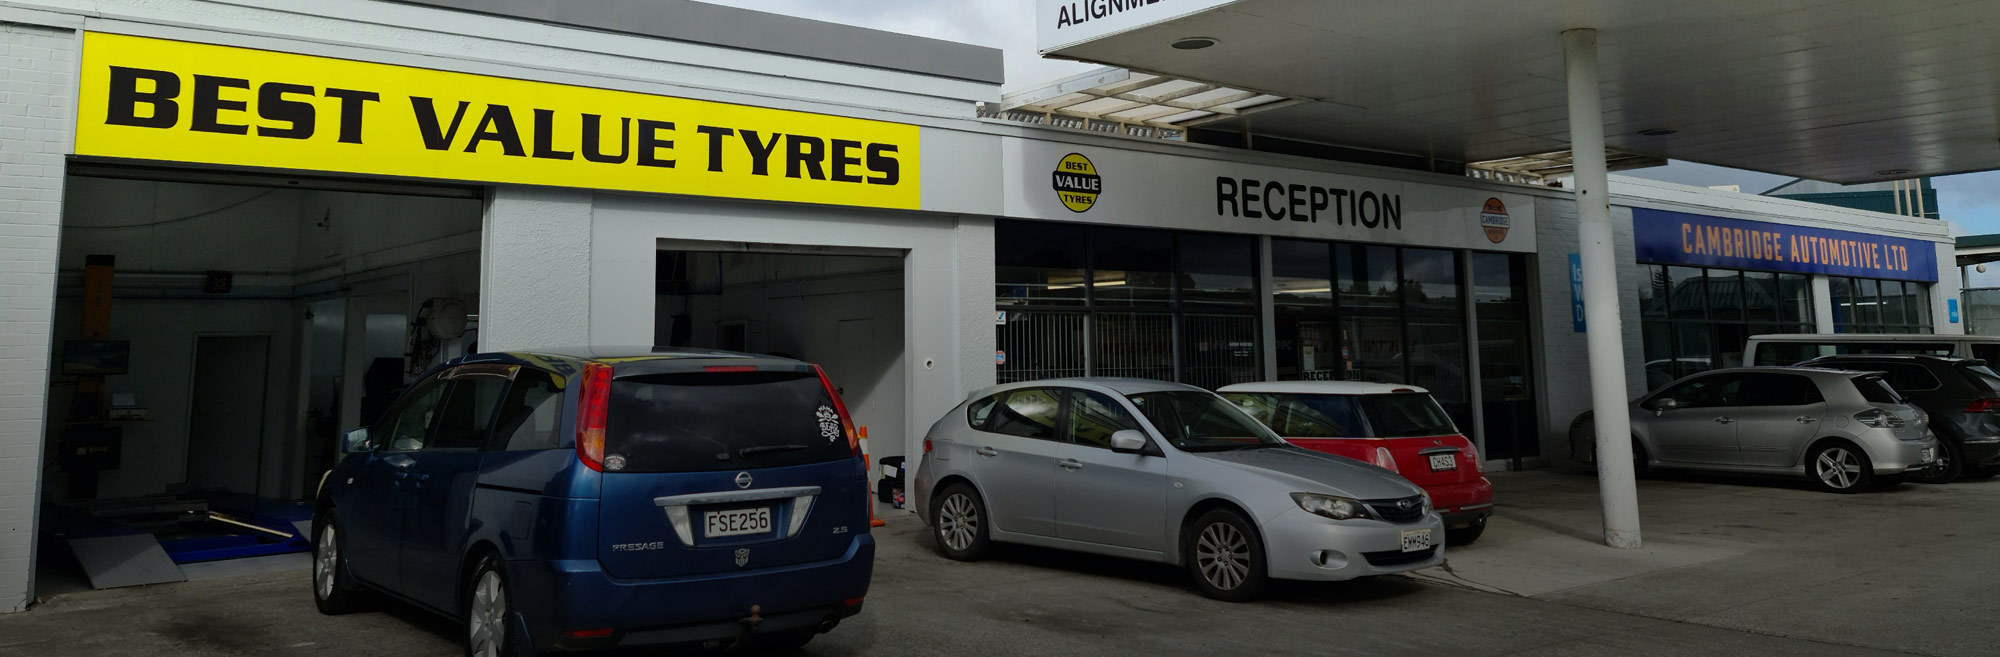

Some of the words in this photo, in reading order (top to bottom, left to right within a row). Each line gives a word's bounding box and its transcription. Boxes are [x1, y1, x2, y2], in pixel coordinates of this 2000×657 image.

[104, 65, 381, 144] BEST
[409, 95, 677, 169] VALUE
[696, 124, 900, 186] TYRES
[1065, 161, 1088, 171] BEST
[1055, 174, 1100, 191] VALUE
[1064, 194, 1093, 205] TYRES
[1216, 176, 1402, 230] RECEPTION
[1682, 222, 1783, 262] CAMBRIDGE
[1790, 234, 1881, 270] AUTOMOTIVE
[1884, 244, 1908, 272] LTD
[708, 513, 768, 533] FSE256
[612, 541, 665, 552] PRESAGE
